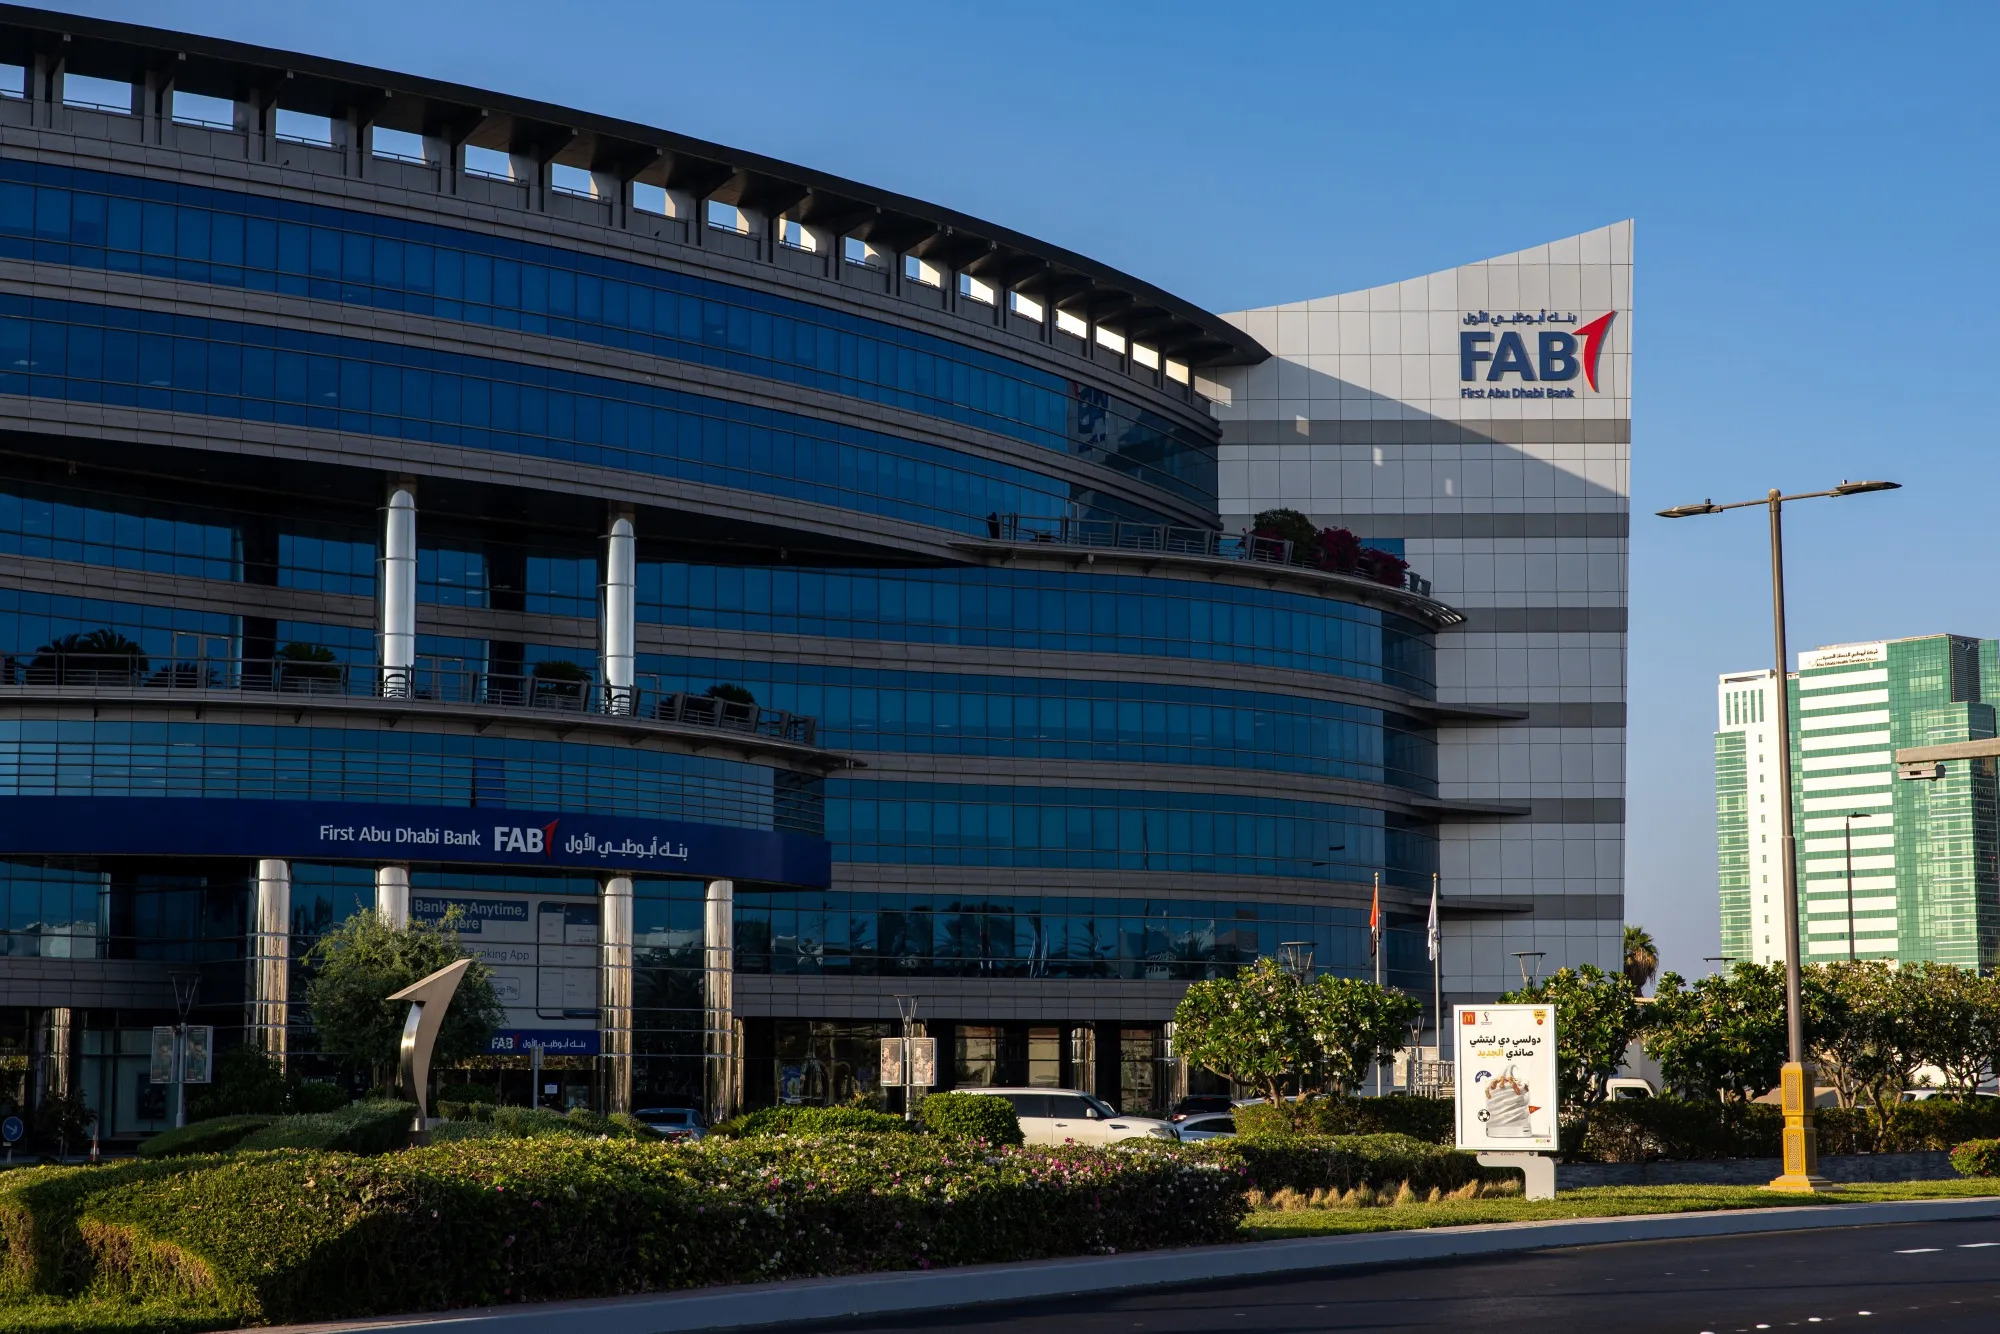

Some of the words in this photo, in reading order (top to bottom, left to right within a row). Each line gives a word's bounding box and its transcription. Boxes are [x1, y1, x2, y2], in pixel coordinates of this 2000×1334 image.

[1546, 311, 1578, 325] بنك
[1461, 388, 1486, 399] First
[1487, 388, 1510, 399] Abu
[1512, 387, 1544, 399] Dhabi
[1546, 388, 1575, 399] Bank
[320, 825, 354, 842] First
[359, 826, 391, 843] Abu
[395, 827, 440, 845] Dhabi
[444, 830, 481, 846] Bank
[565, 832, 596, 854] الأول
[659, 841, 689, 861] بنك
[469, 901, 526, 918] Anytime,
[509, 949, 530, 962] App
[570, 1039, 586, 1050] بنك
[1469, 1034, 1496, 1048] ليتشي
[1498, 1037, 1510, 1048] دي
[1512, 1035, 1541, 1048] دولسي
[1477, 1048, 1504, 1059] الجديد
[1505, 1048, 1534, 1061] صاندي
